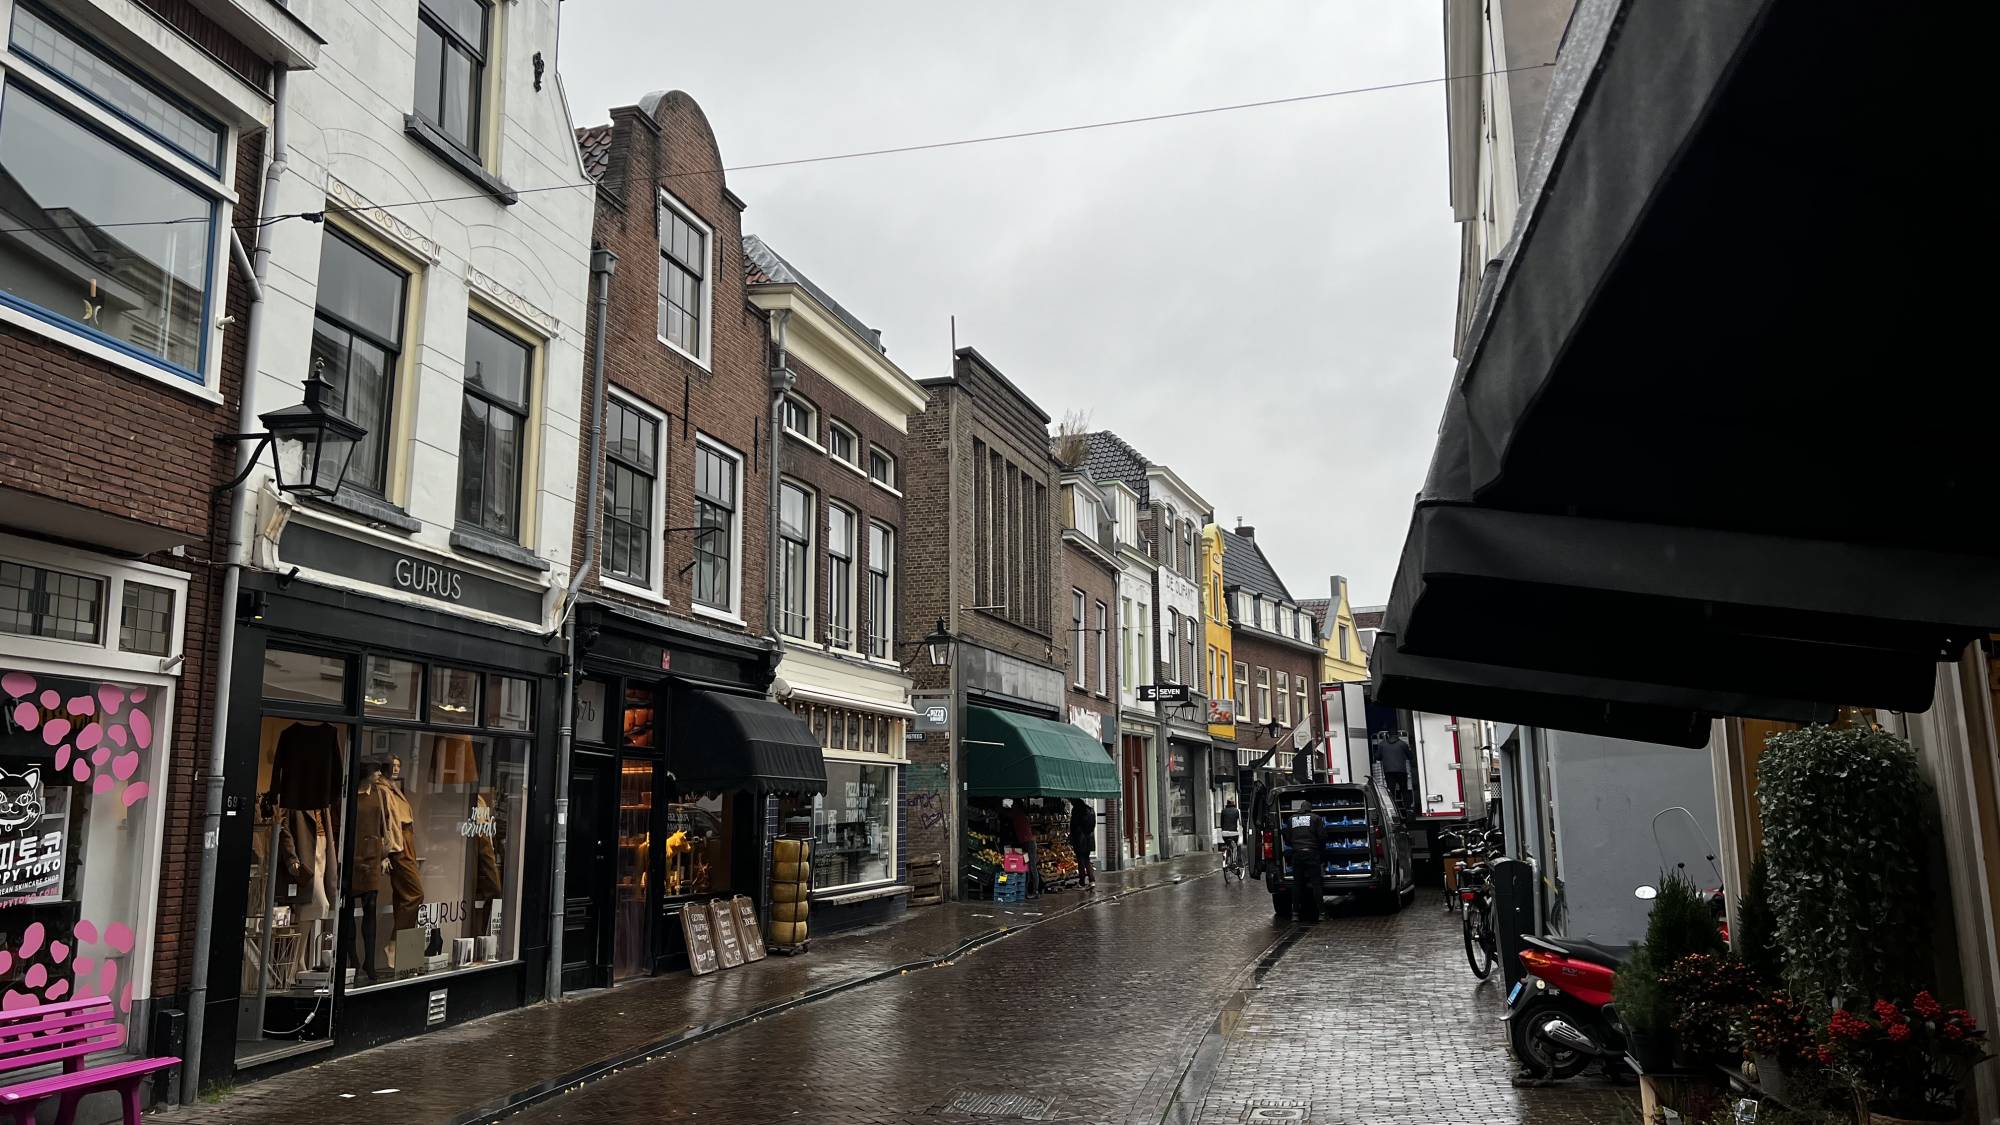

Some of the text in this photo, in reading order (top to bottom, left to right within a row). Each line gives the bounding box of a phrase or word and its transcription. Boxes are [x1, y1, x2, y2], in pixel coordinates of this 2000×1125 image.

[396, 558, 461, 599] GURUS
[1147, 688, 1156, 698] S
[0, 831, 62, 870] 피토코
[25, 858, 61, 878] TOKO
[14, 879, 42, 892] SKINCARE
[416, 900, 467, 926] GURUS
